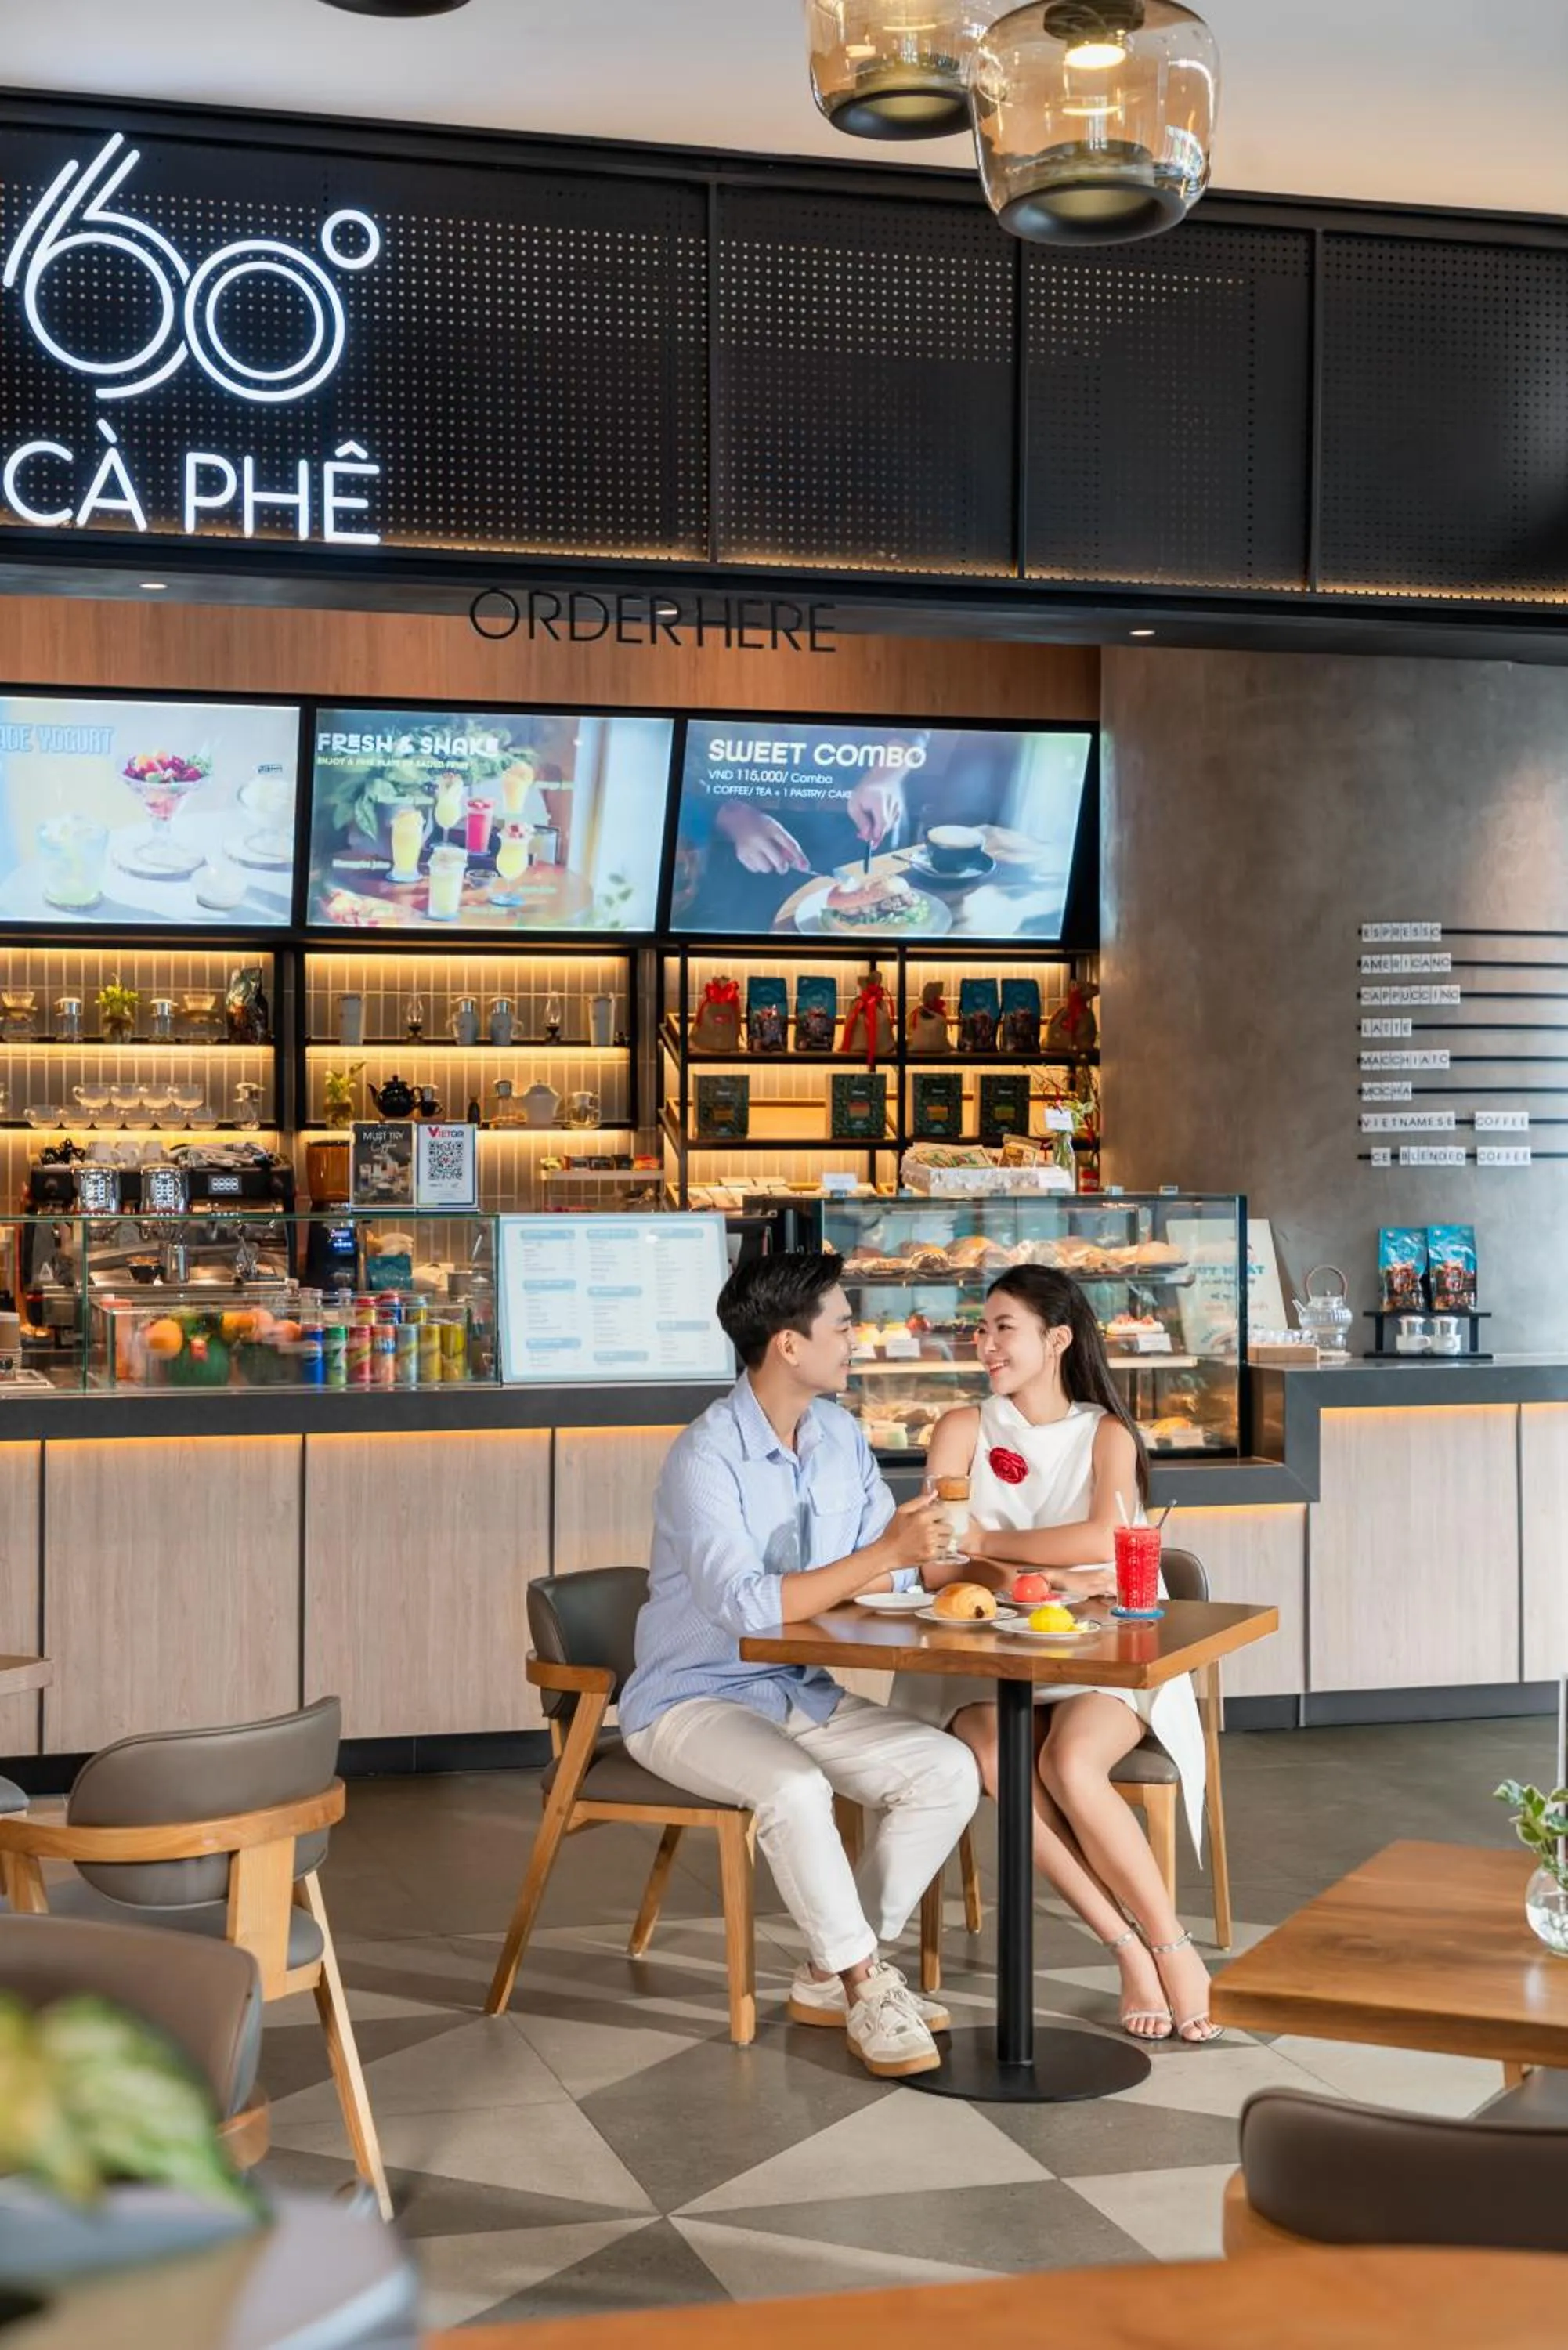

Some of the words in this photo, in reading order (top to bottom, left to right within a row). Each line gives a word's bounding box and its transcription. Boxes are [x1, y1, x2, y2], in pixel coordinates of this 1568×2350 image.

[3, 418, 147, 533] CÀ
[184, 439, 381, 545] PHÊ
[470, 588, 681, 646] ORDER
[696, 595, 837, 653] HERE
[316, 732, 393, 754] FRESH
[420, 736, 500, 758] SHAKE
[708, 739, 807, 765] SWEET
[813, 743, 927, 769] COMBO
[708, 770, 734, 781] VND
[756, 786, 772, 797] TEA
[1363, 924, 1441, 938] ESPRESSO
[1362, 956, 1451, 971] AMERICANO
[1362, 988, 1460, 1003] CAPPUCCINO
[1363, 1021, 1411, 1035] LATTE
[1361, 1053, 1449, 1067] MACCHIATO
[1363, 1084, 1411, 1097] MOCHA
[1362, 1113, 1455, 1129] VIETNAMESE
[1476, 1114, 1529, 1128] COFFEE
[363, 1130, 387, 1141] MUST
[1477, 1150, 1530, 1163] COFFEE
